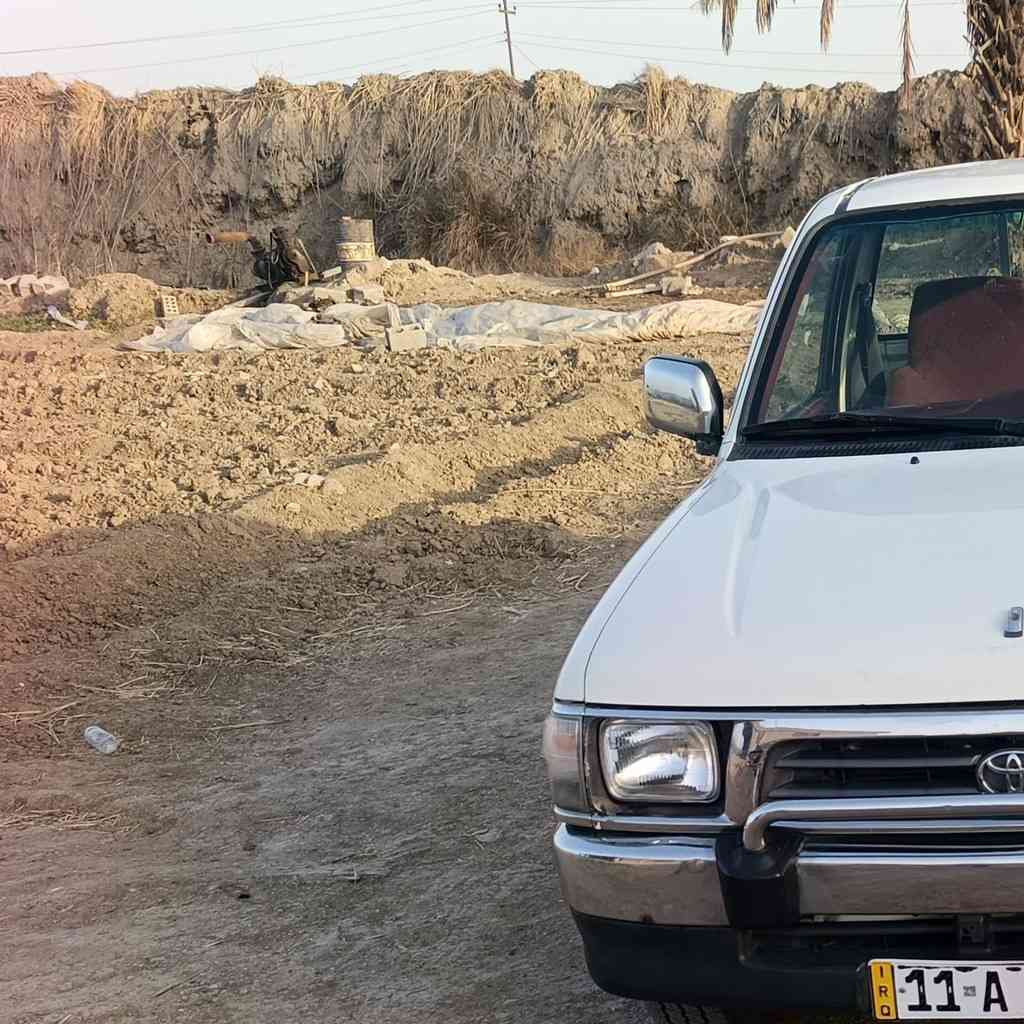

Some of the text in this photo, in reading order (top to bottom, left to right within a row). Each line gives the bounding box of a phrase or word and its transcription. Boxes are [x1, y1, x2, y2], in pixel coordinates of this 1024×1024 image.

[879, 965, 891, 1017] IRQ
[905, 969, 961, 1012] 11
[983, 971, 1008, 1012] A
